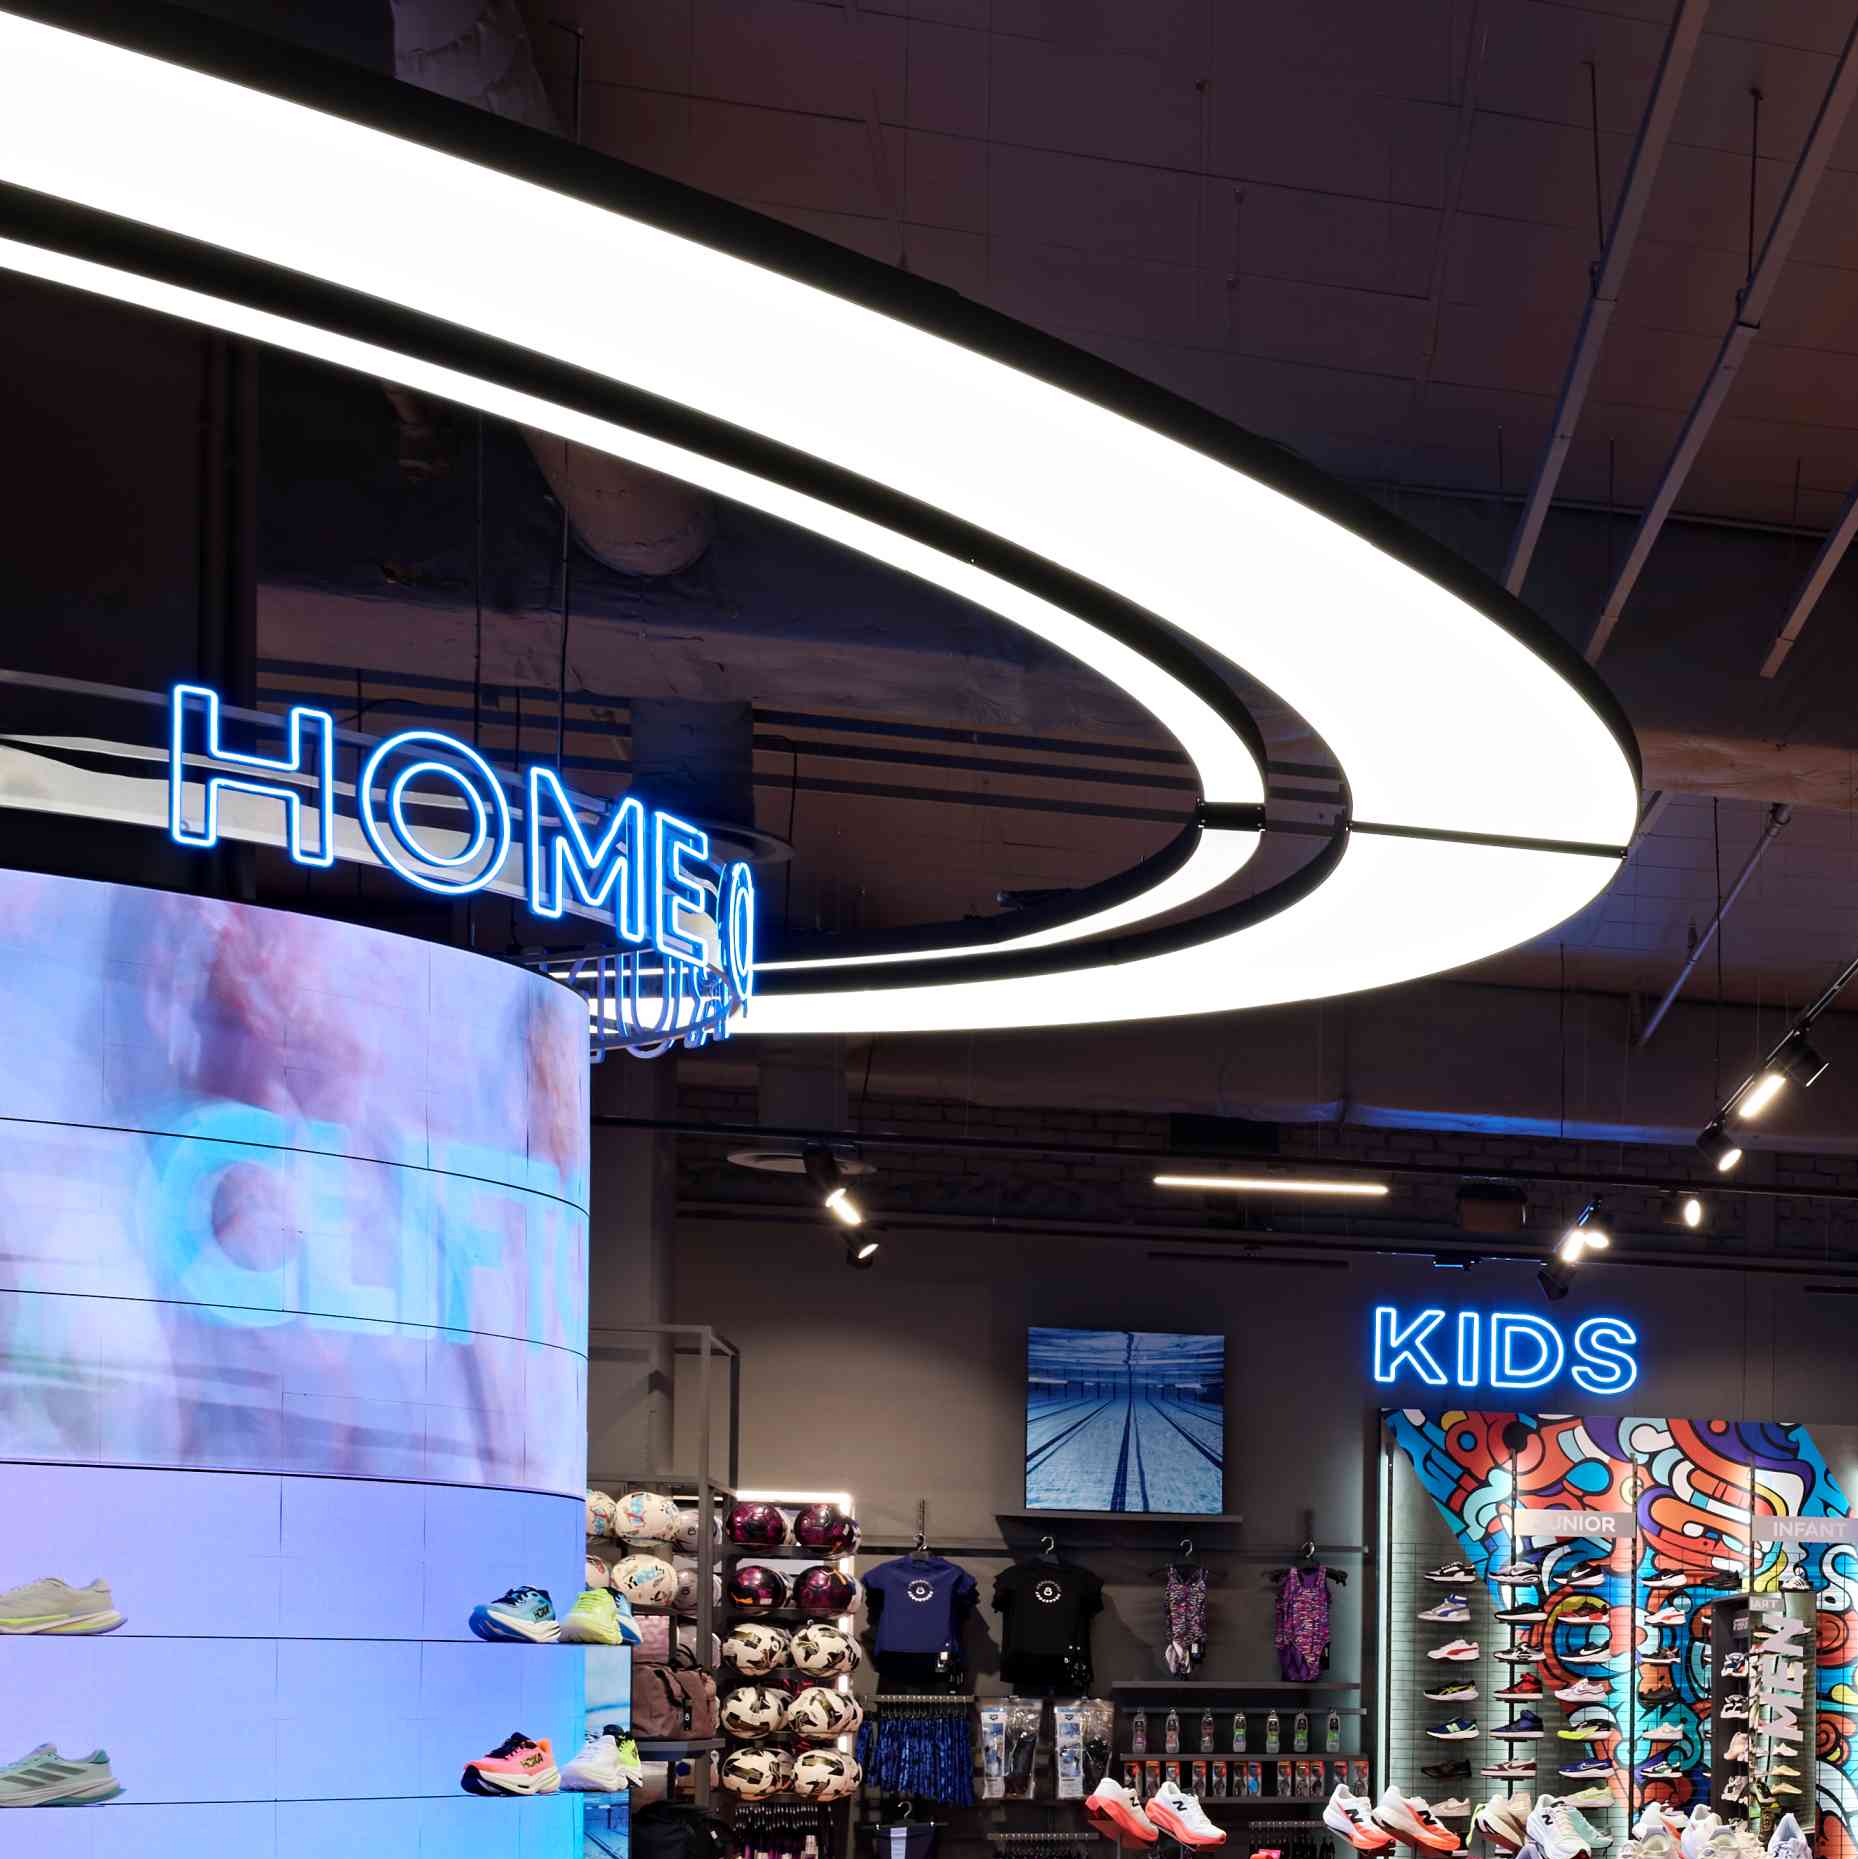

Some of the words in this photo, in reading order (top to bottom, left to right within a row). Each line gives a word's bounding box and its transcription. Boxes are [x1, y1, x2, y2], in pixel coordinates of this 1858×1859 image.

[170, 683, 710, 966] HOME
[1373, 1306, 1638, 1395] KIDS
[1548, 1515, 1616, 1533] UNIOR
[1773, 1522, 1847, 1537] INFANT
